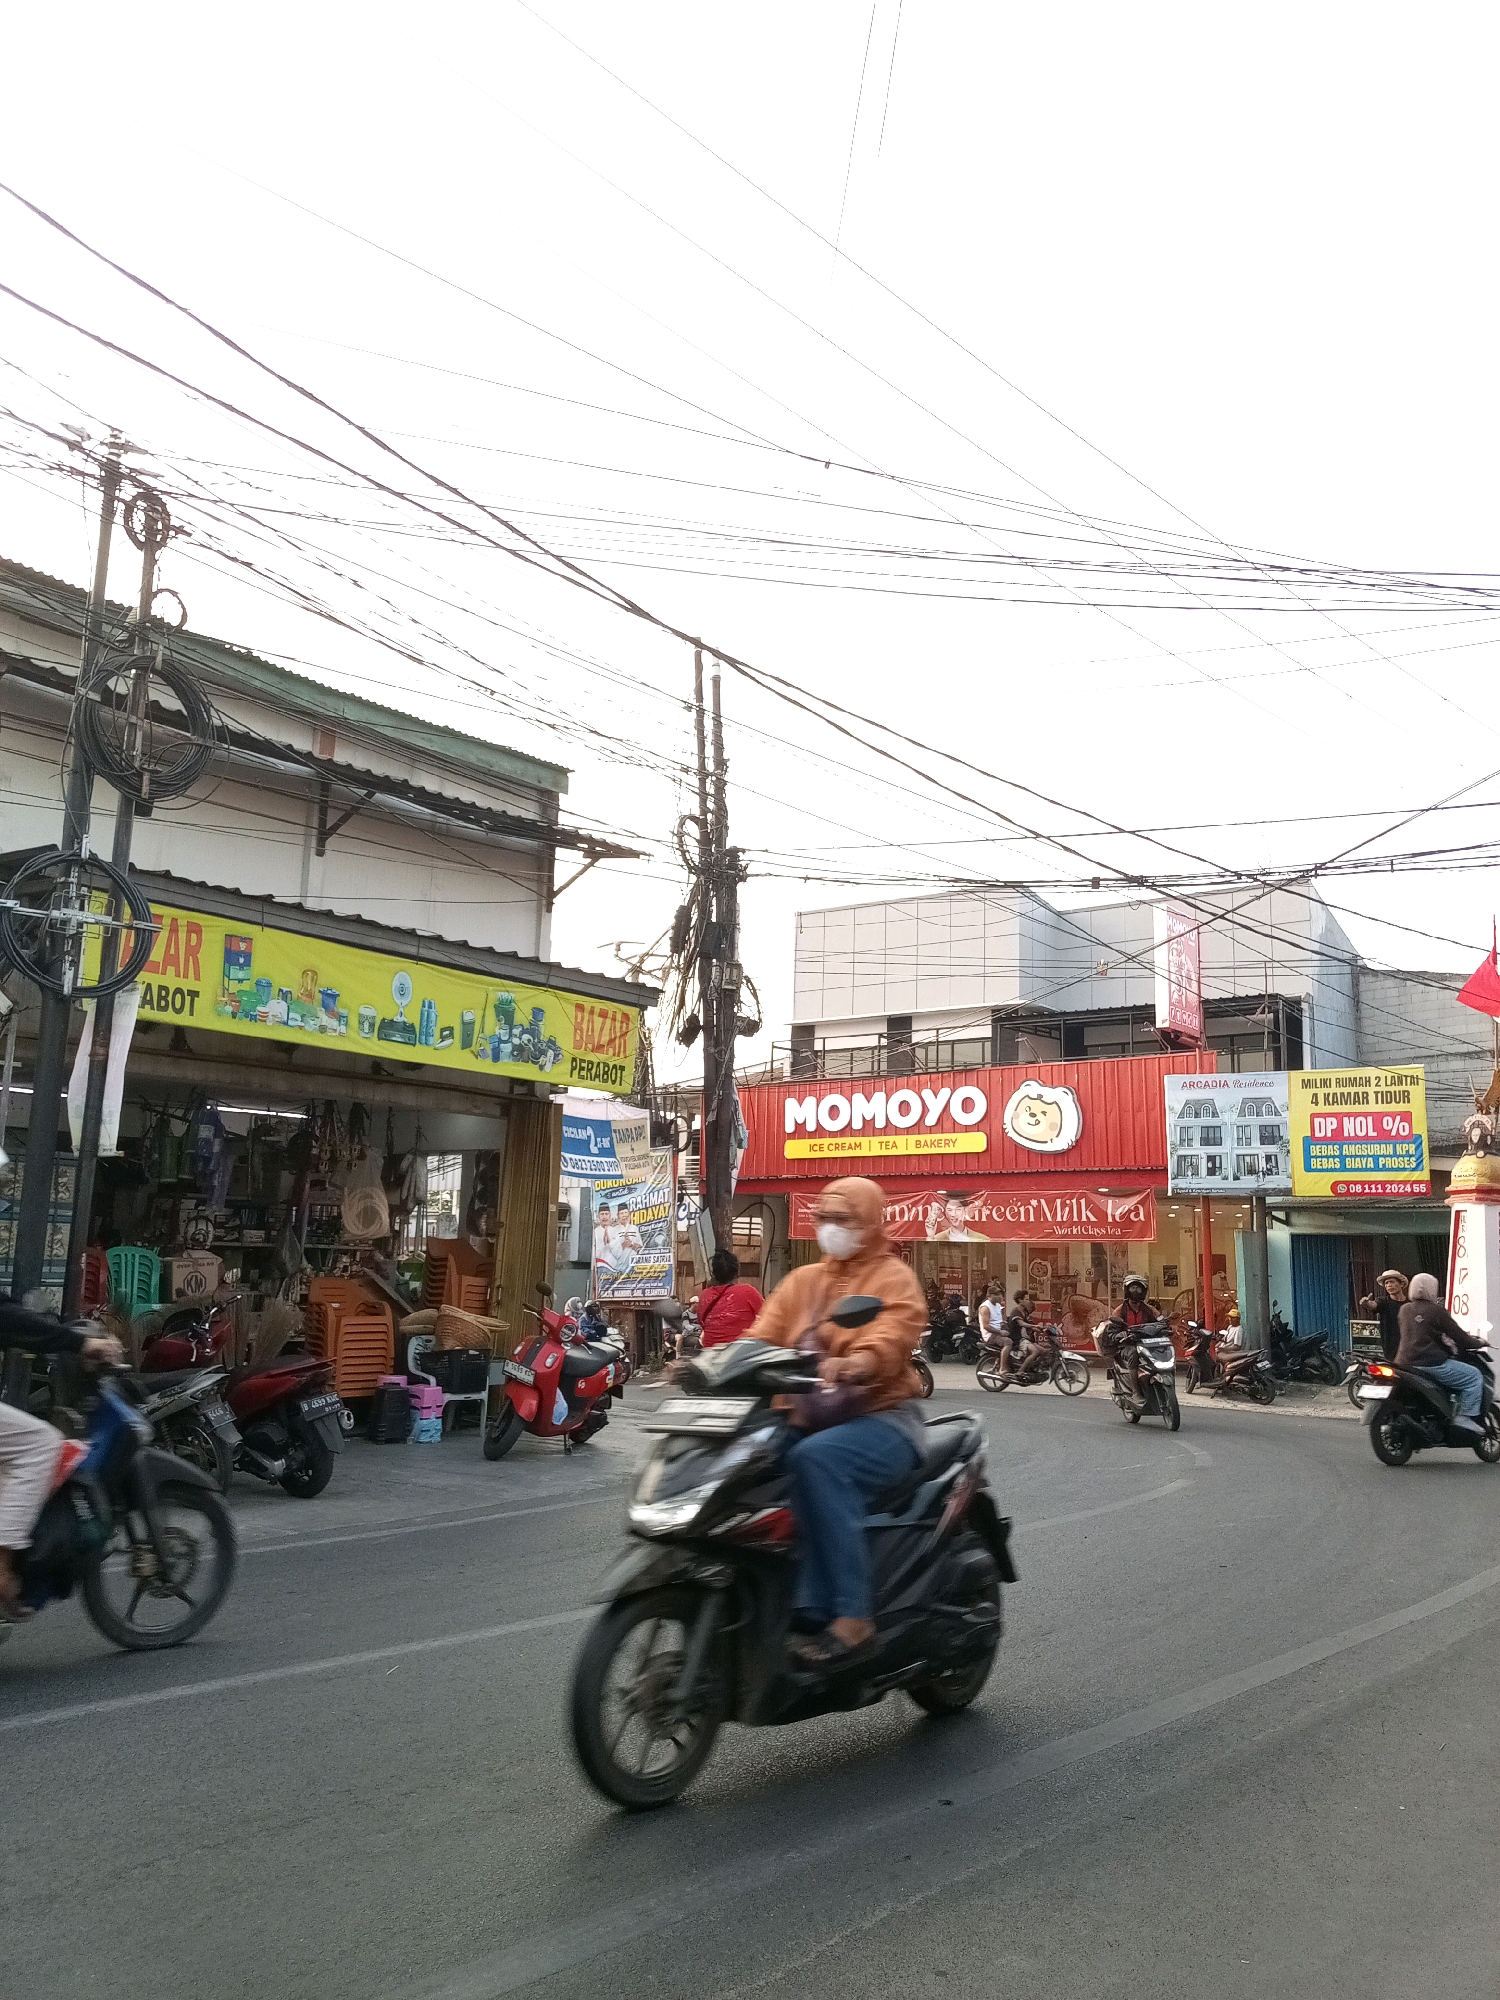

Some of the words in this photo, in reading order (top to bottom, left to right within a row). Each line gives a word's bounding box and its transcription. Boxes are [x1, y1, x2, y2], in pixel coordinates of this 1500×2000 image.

[572, 1002, 631, 1059] BAZAR
[569, 1057, 626, 1087] PERABOT
[1301, 1078, 1332, 1089] MILIKI
[1335, 1076, 1371, 1089] RUMAH
[1374, 1076, 1382, 1088] 2
[1384, 1074, 1419, 1087] LANTAI
[1181, 1079, 1230, 1089] ARCADIA
[1232, 1078, 1274, 1088] Residence
[1310, 1092, 1319, 1106] 4
[1323, 1091, 1370, 1106] KAMAR
[1373, 1090, 1411, 1105] TIDUR
[784, 1085, 987, 1133] MOMOYO
[1313, 1117, 1337, 1138] DP
[1342, 1116, 1377, 1137] NOL
[1382, 1115, 1410, 1136] %
[586, 1125, 599, 1154] 2
[809, 1143, 825, 1153] ICE
[827, 1142, 862, 1152] CREAM
[878, 1141, 899, 1151] TEA
[915, 1138, 958, 1149] BAKERY
[1310, 1145, 1340, 1156] BEBAS
[1342, 1144, 1393, 1156] ANGSURAN
[1396, 1143, 1416, 1155] KPR
[1310, 1158, 1340, 1169] BEBAS
[1345, 1158, 1374, 1169] BIAYA
[1379, 1157, 1417, 1169] PROSES
[1349, 1184, 1362, 1193] 08
[1363, 1184, 1383, 1193] 111
[1385, 1184, 1411, 1193] 2024
[1412, 1184, 1427, 1193] 55
[629, 1187, 670, 1211] RAHMAT
[631, 1203, 670, 1225] HIDAYAT
[964, 1199, 1036, 1222] Green
[1039, 1197, 1098, 1222] Milk
[1100, 1198, 1145, 1222] Tea
[1053, 1225, 1080, 1235] World
[1081, 1225, 1106, 1236] Class
[1105, 1225, 1121, 1235] Tea
